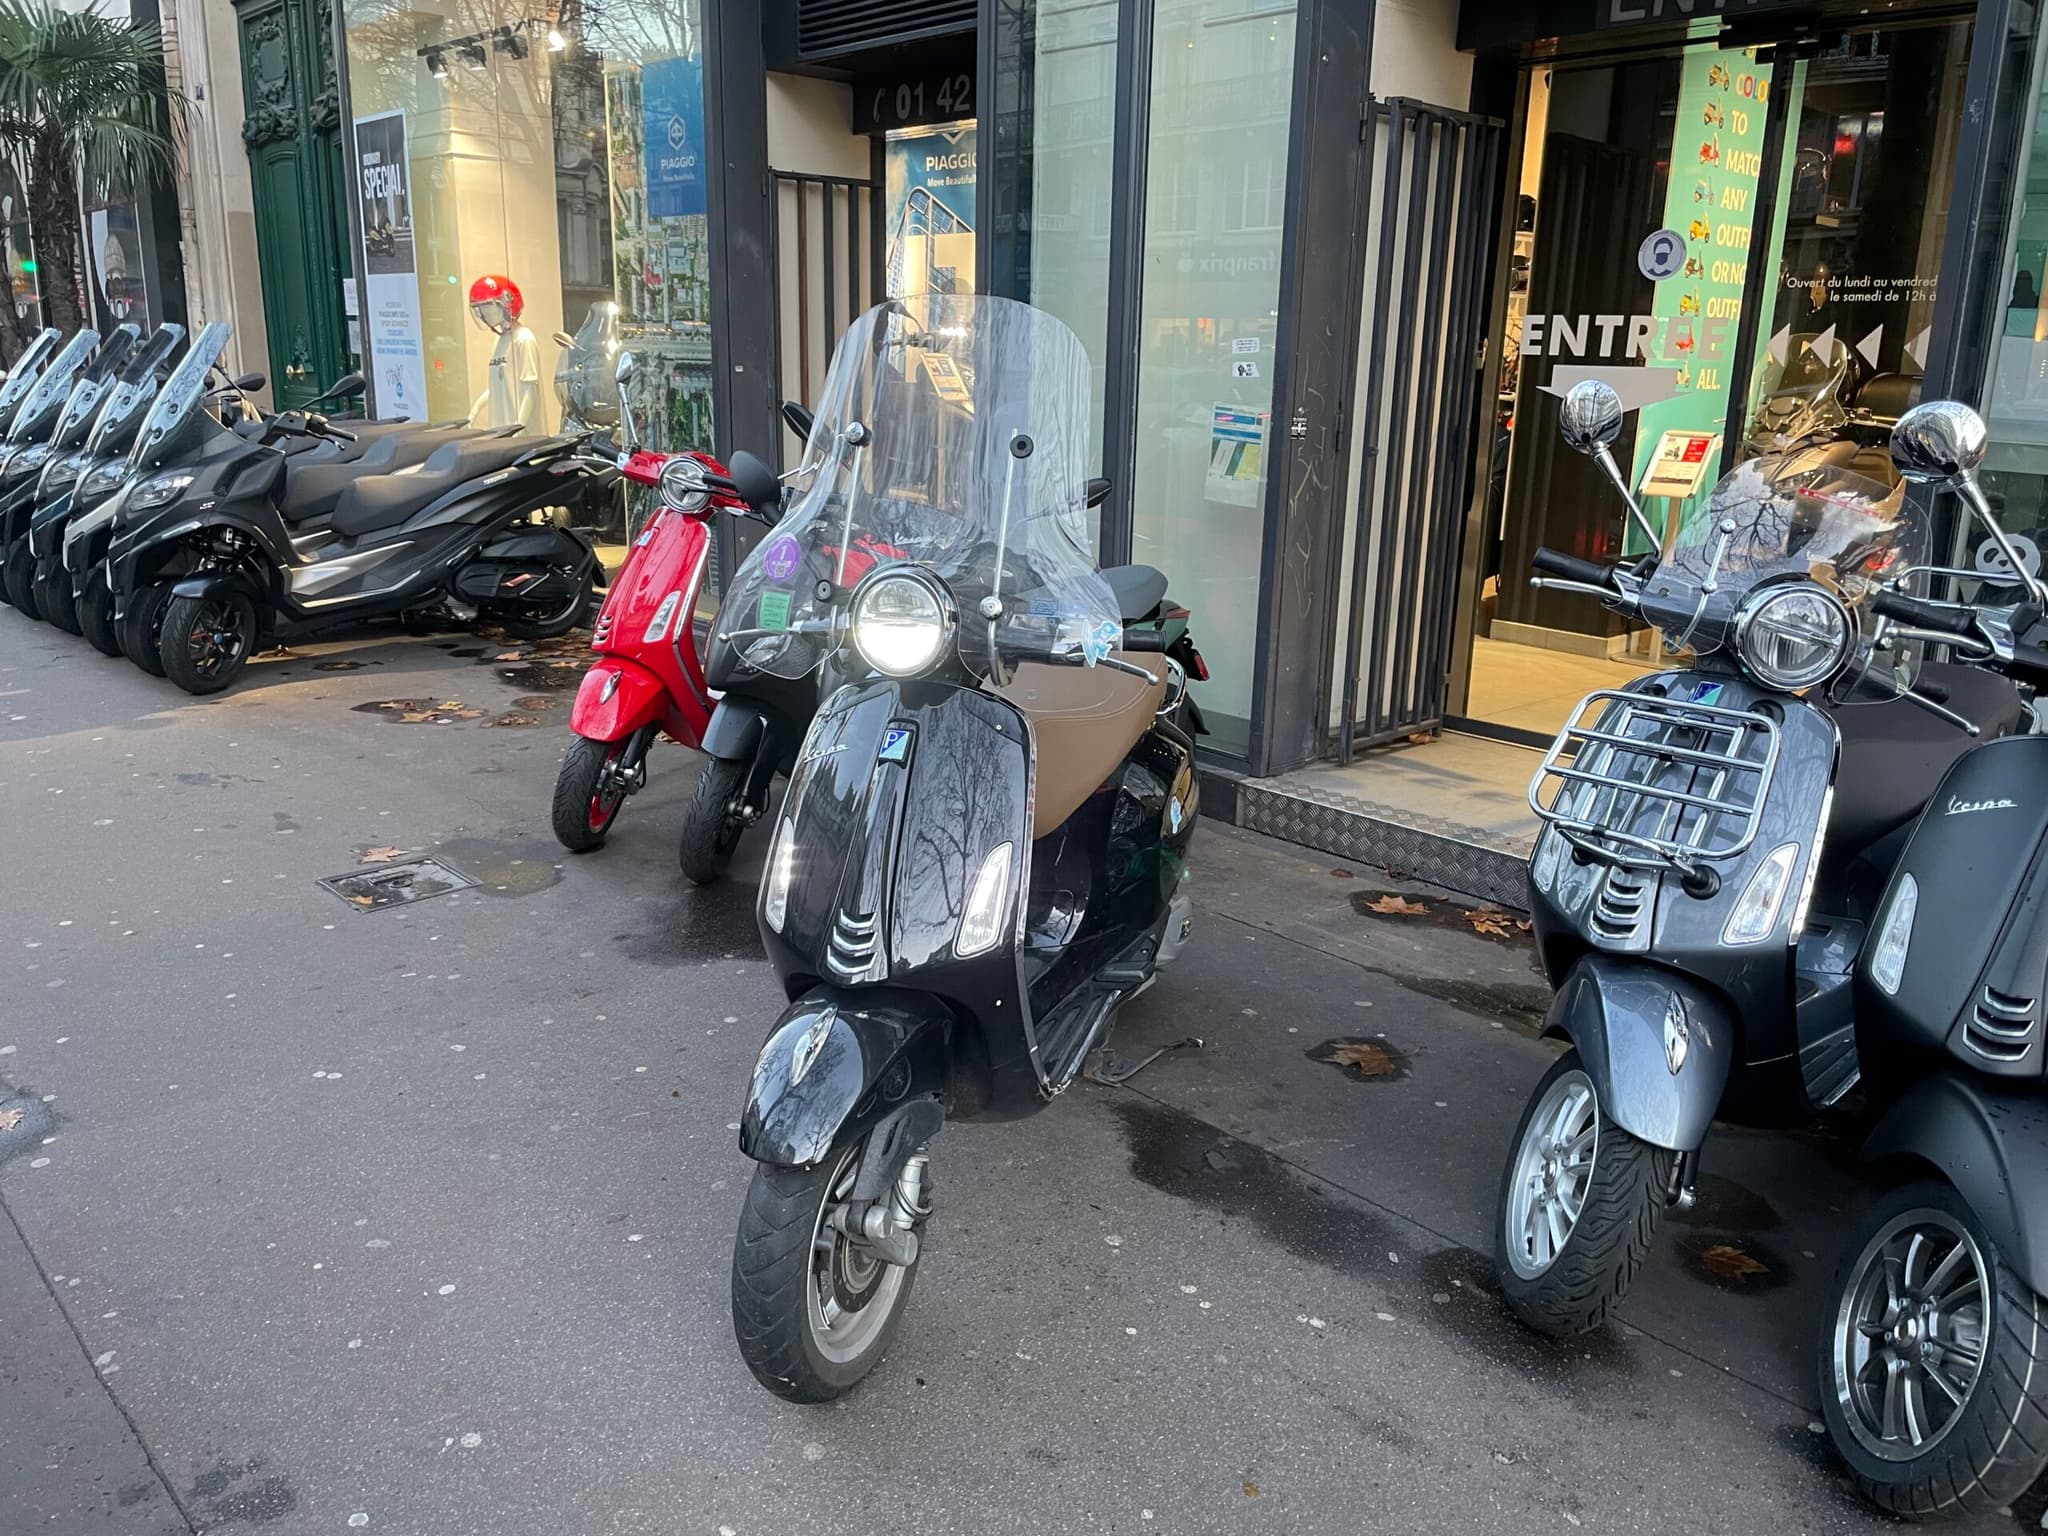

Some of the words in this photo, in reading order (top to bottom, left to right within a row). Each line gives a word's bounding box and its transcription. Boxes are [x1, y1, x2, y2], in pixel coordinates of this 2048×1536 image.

[896, 81, 924, 119] 01
[936, 74, 971, 113] 42
[1732, 109, 1748, 136] TO
[661, 155, 695, 170] PIAGGIO
[1720, 186, 1748, 212] ANY
[1711, 260, 1728, 283] OR
[1786, 276, 1825, 288] Ouvert
[1828, 275, 1842, 288] du
[1844, 275, 1871, 288] lundi
[1873, 279, 1887, 288] au
[1830, 290, 1840, 302] le
[1843, 289, 1882, 302] samedi
[1884, 289, 1900, 302] de
[1696, 368, 1720, 390] ALL.
[885, 731, 898, 748] P
[803, 743, 850, 764] Vespa
[1944, 793, 2019, 816] Vespa
